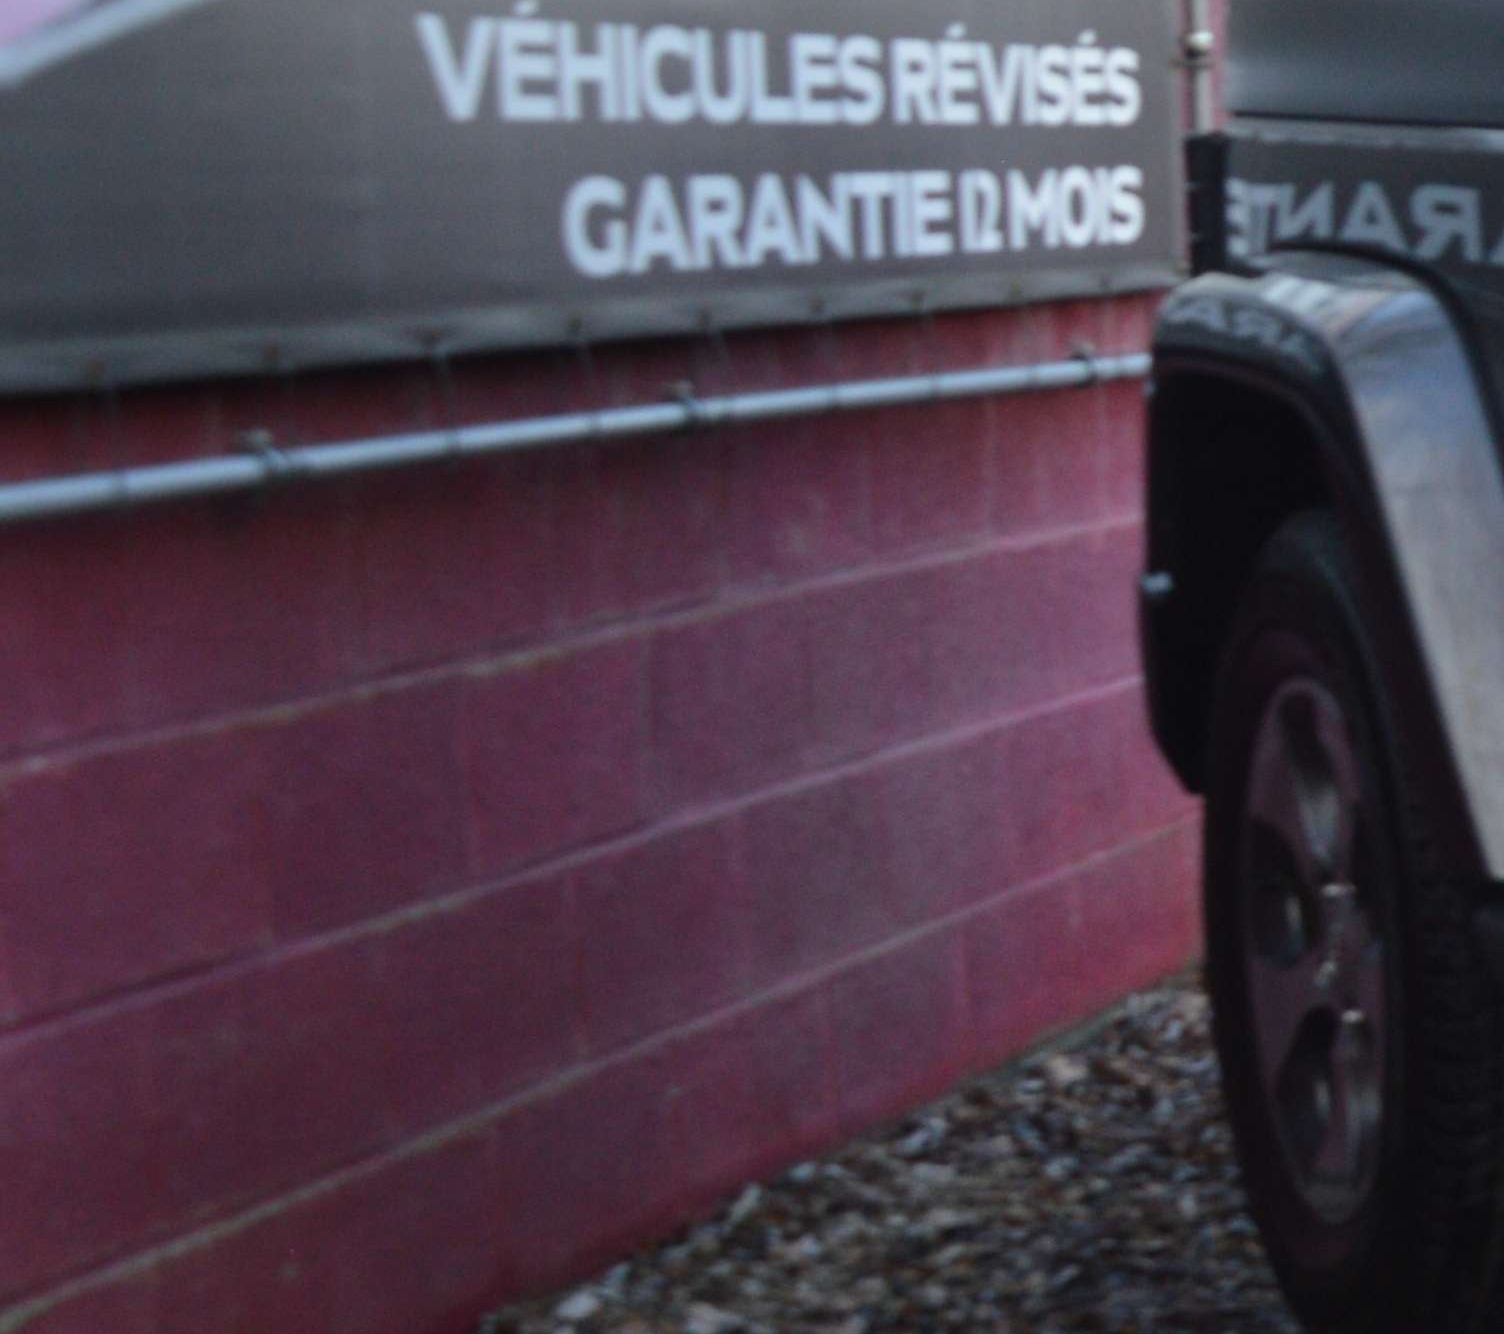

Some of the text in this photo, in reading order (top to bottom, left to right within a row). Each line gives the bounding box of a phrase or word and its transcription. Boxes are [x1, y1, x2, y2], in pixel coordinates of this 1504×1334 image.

[891, 23, 1143, 127] RÉVISÉS
[560, 169, 954, 279] GARANTIE
[1007, 165, 1146, 252] MOIS
